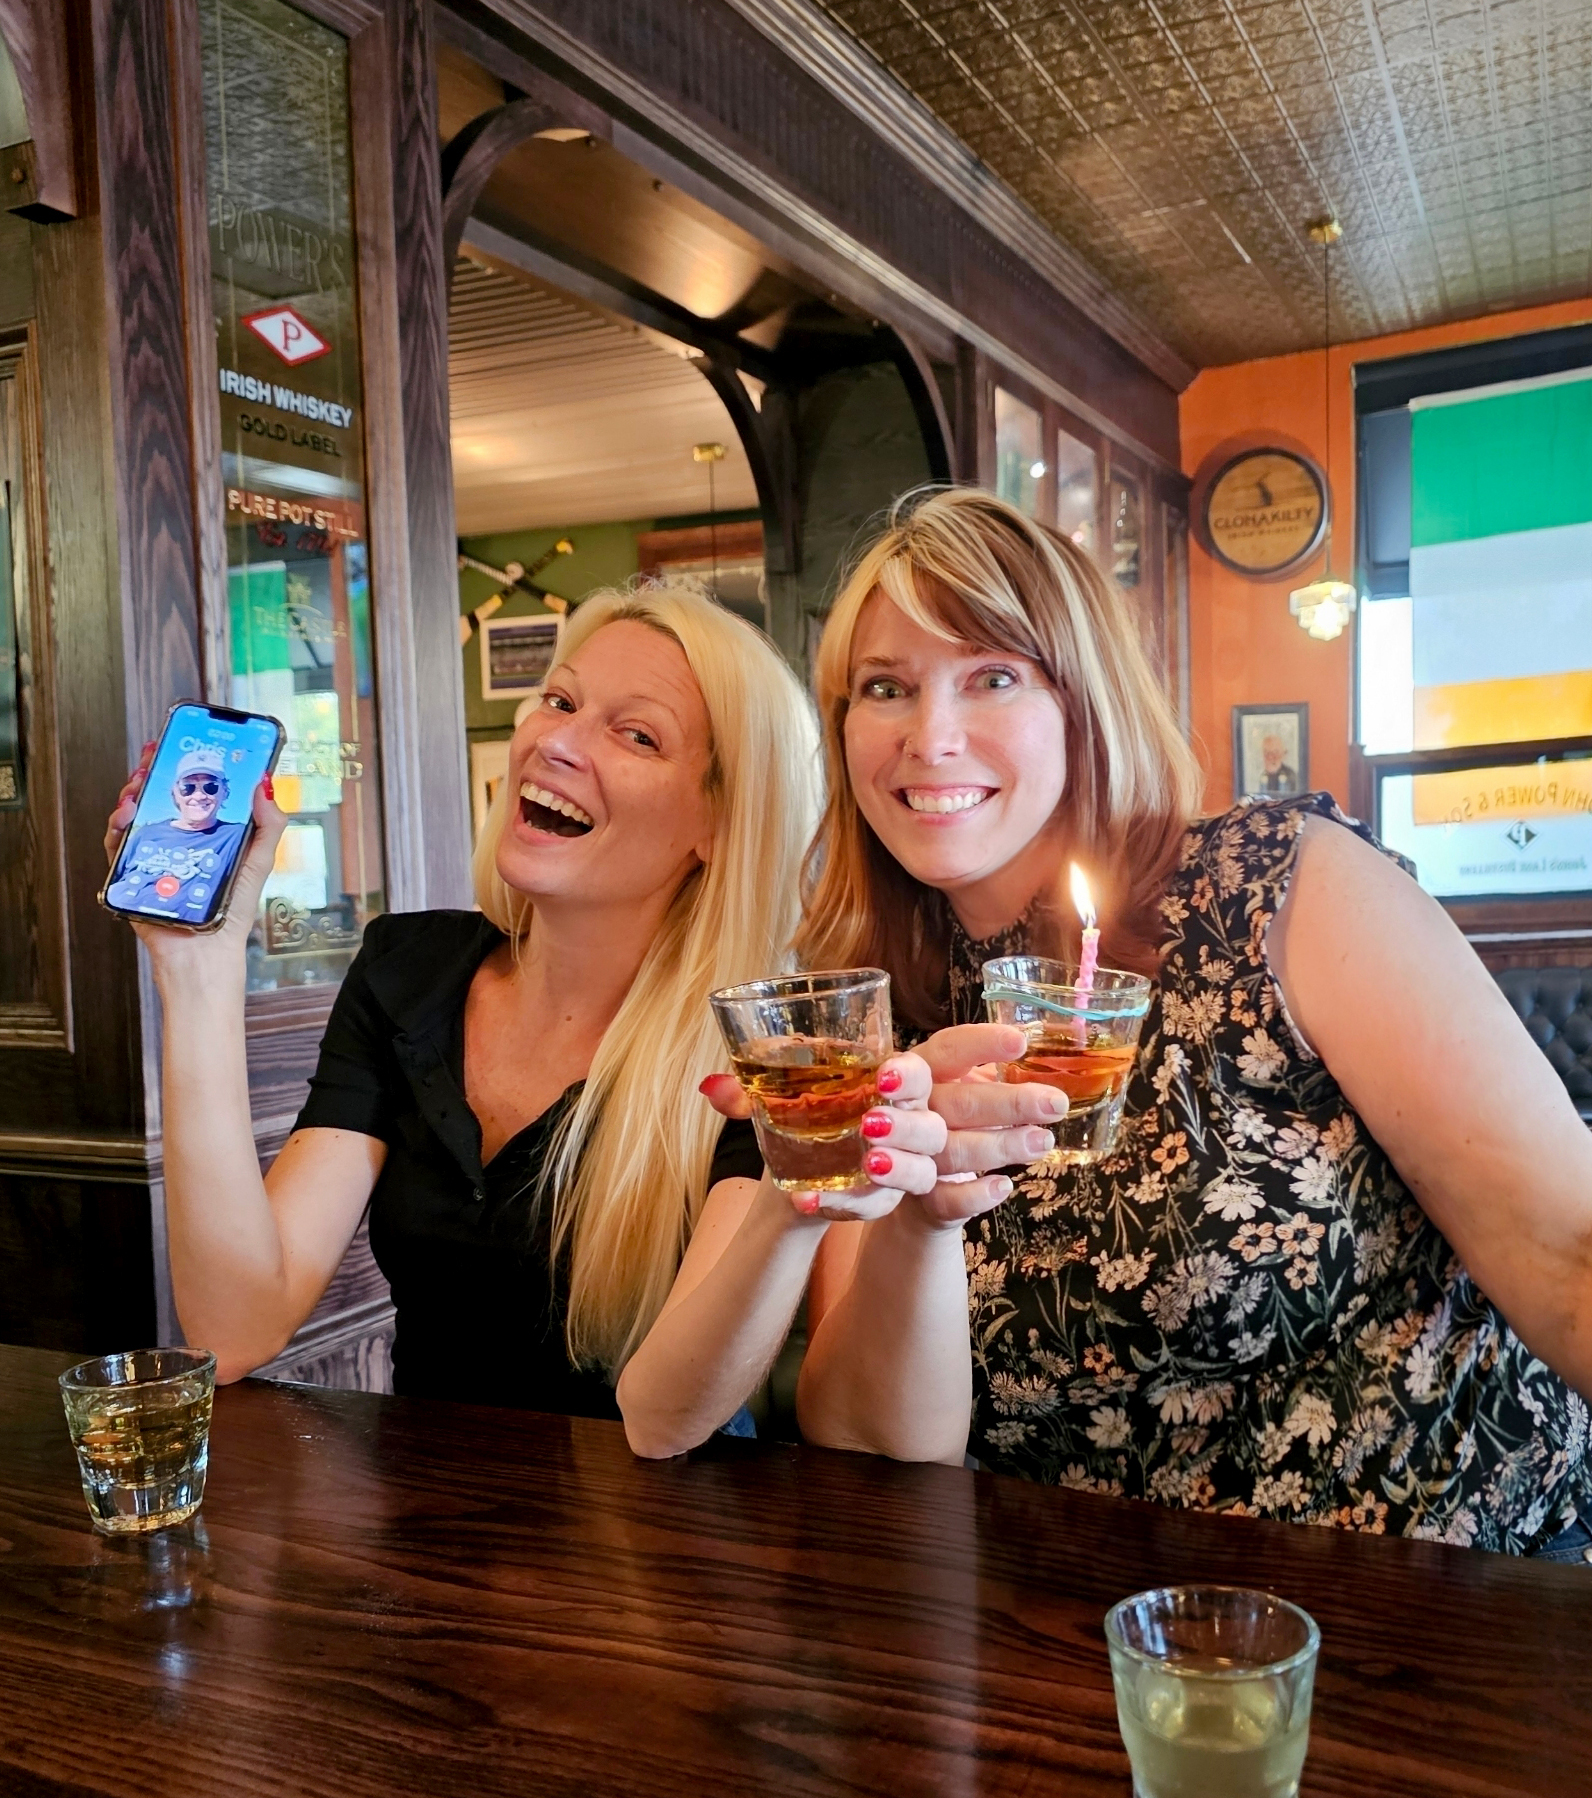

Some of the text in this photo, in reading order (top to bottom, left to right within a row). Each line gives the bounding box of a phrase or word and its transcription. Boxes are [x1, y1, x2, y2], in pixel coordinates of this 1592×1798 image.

[282, 319, 301, 351] P
[219, 368, 352, 428] IRISH WHISKEY
[240, 413, 343, 457] GOLD LABEL
[227, 489, 278, 520] PURE
[279, 500, 313, 527] POT
[1213, 506, 1314, 530] CLONAKILTY
[178, 735, 228, 758] Chris
[279, 757, 364, 780] ELAND
